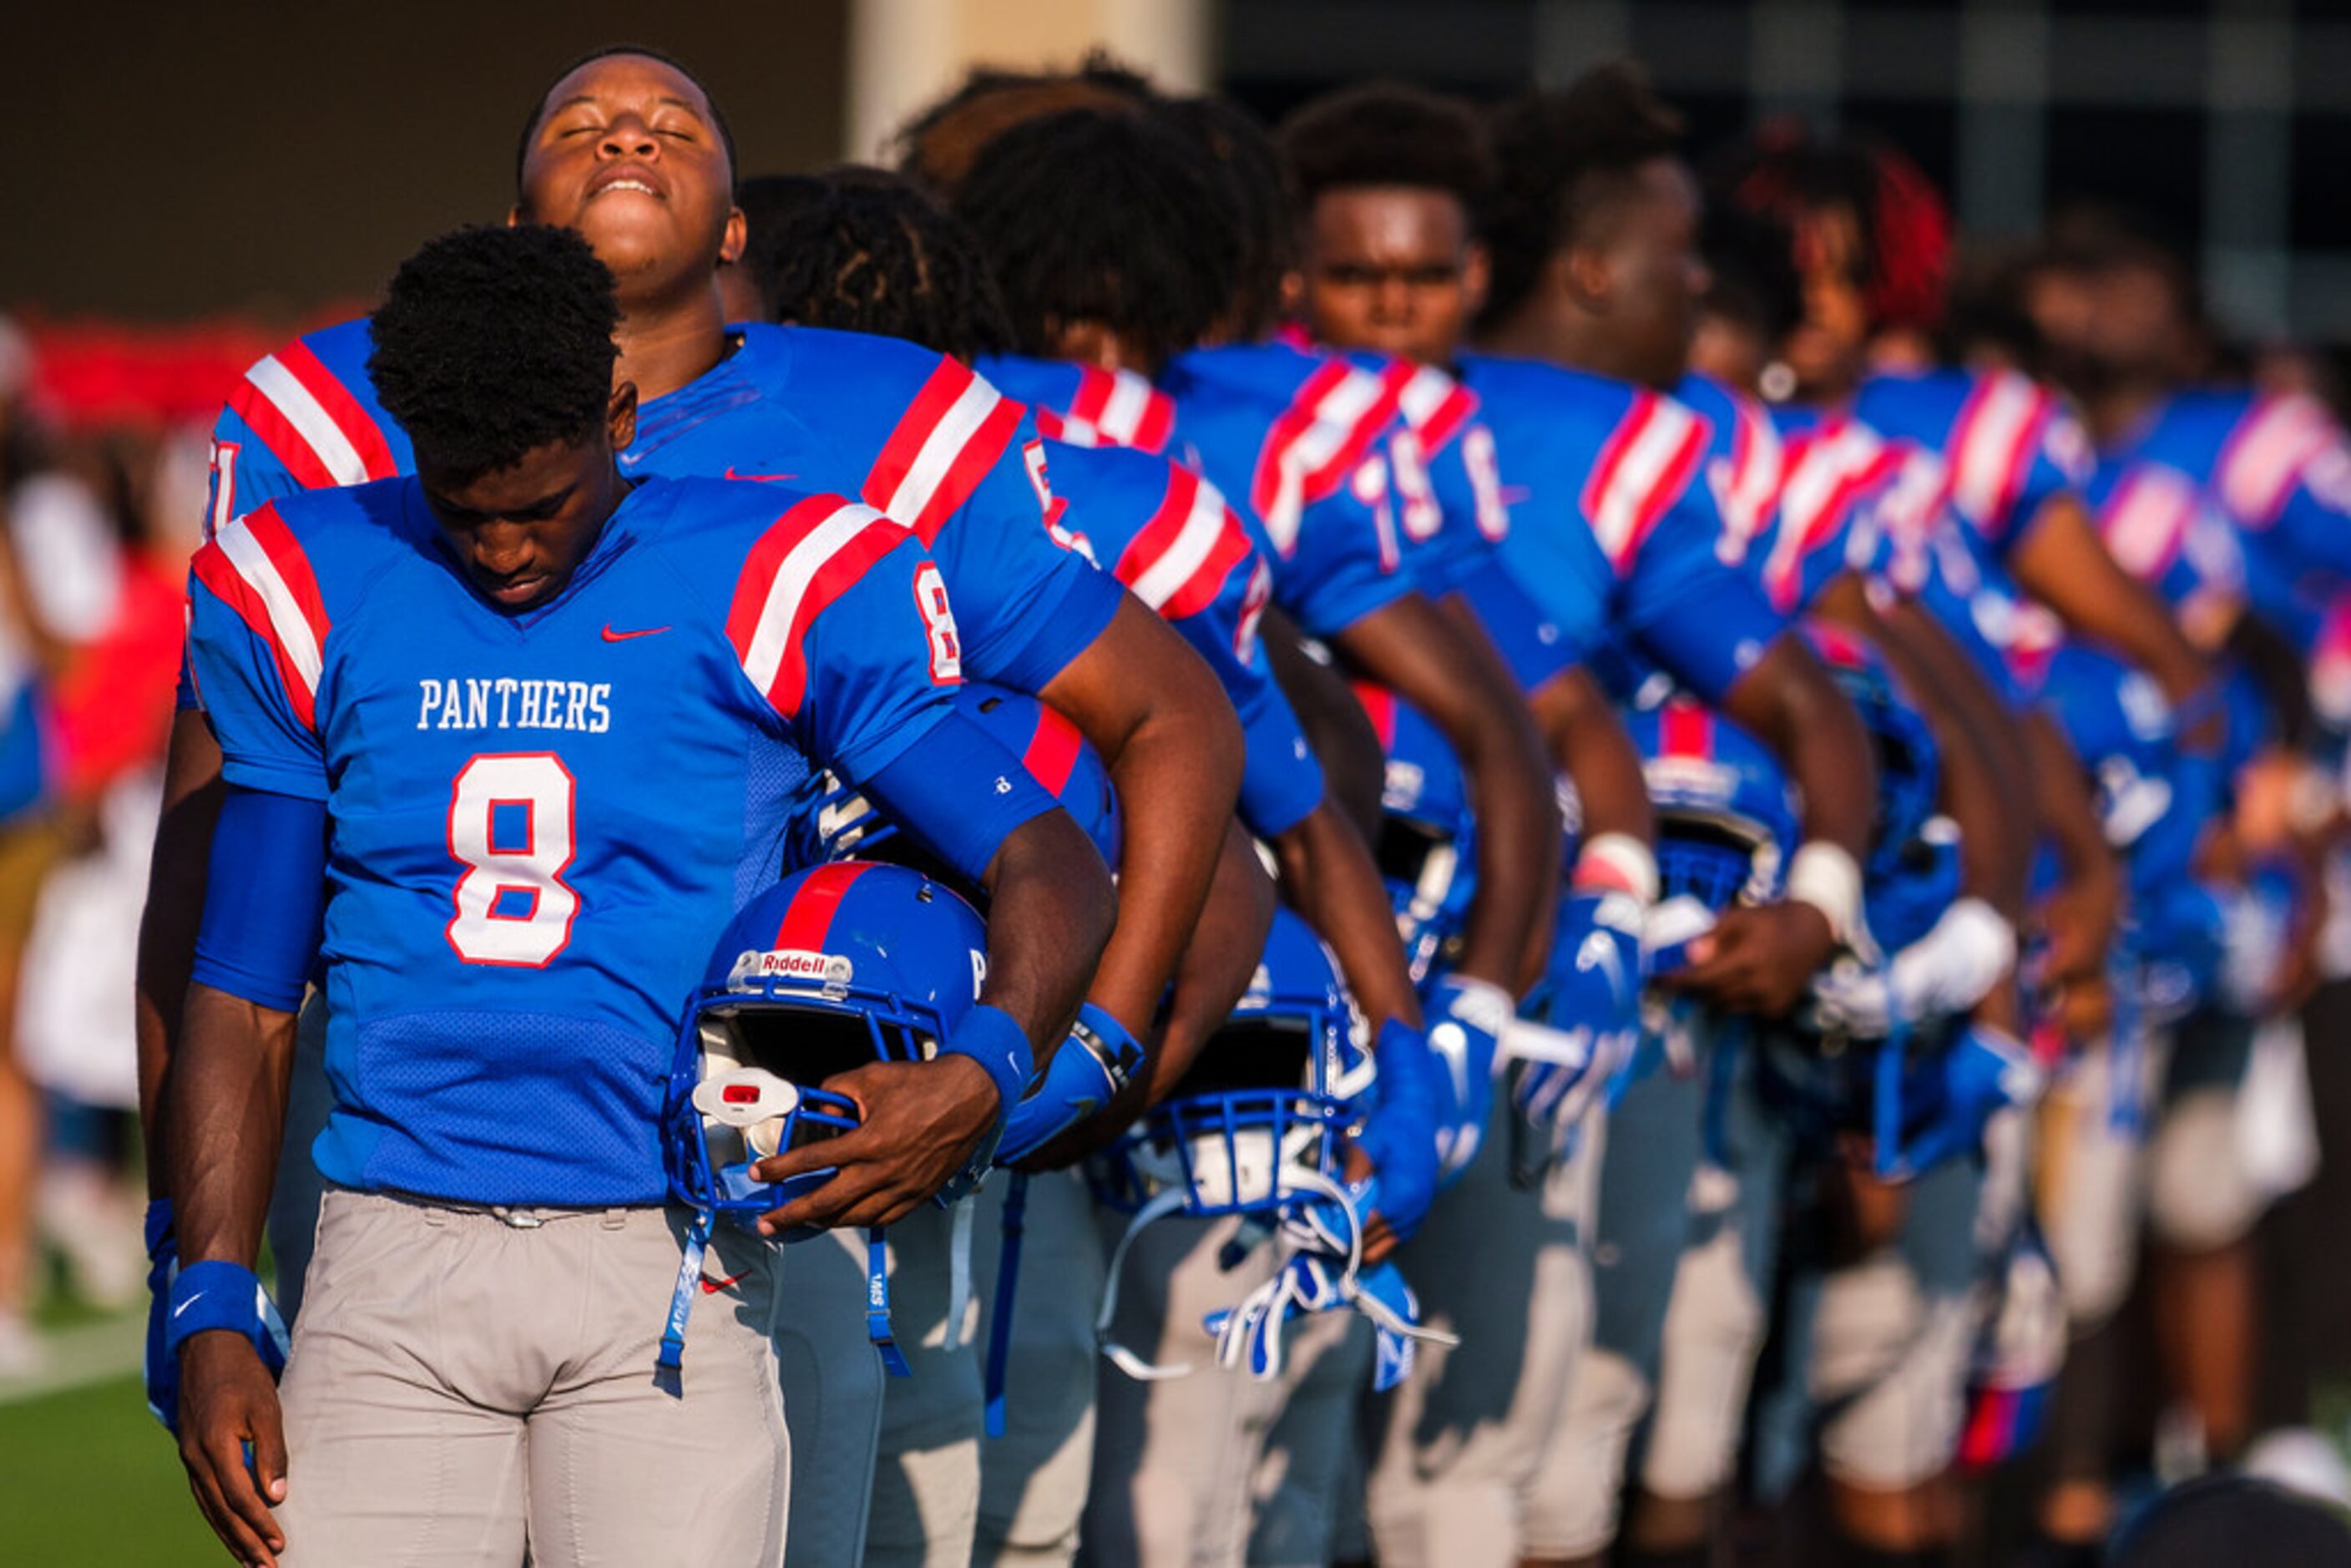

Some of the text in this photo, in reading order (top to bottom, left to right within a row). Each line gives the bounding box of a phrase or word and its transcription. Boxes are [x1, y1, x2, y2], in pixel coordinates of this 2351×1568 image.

[913, 560, 962, 687] 8
[417, 677, 612, 733] PANTHERS
[443, 750, 581, 969] 8
[761, 954, 826, 974] Riddell
